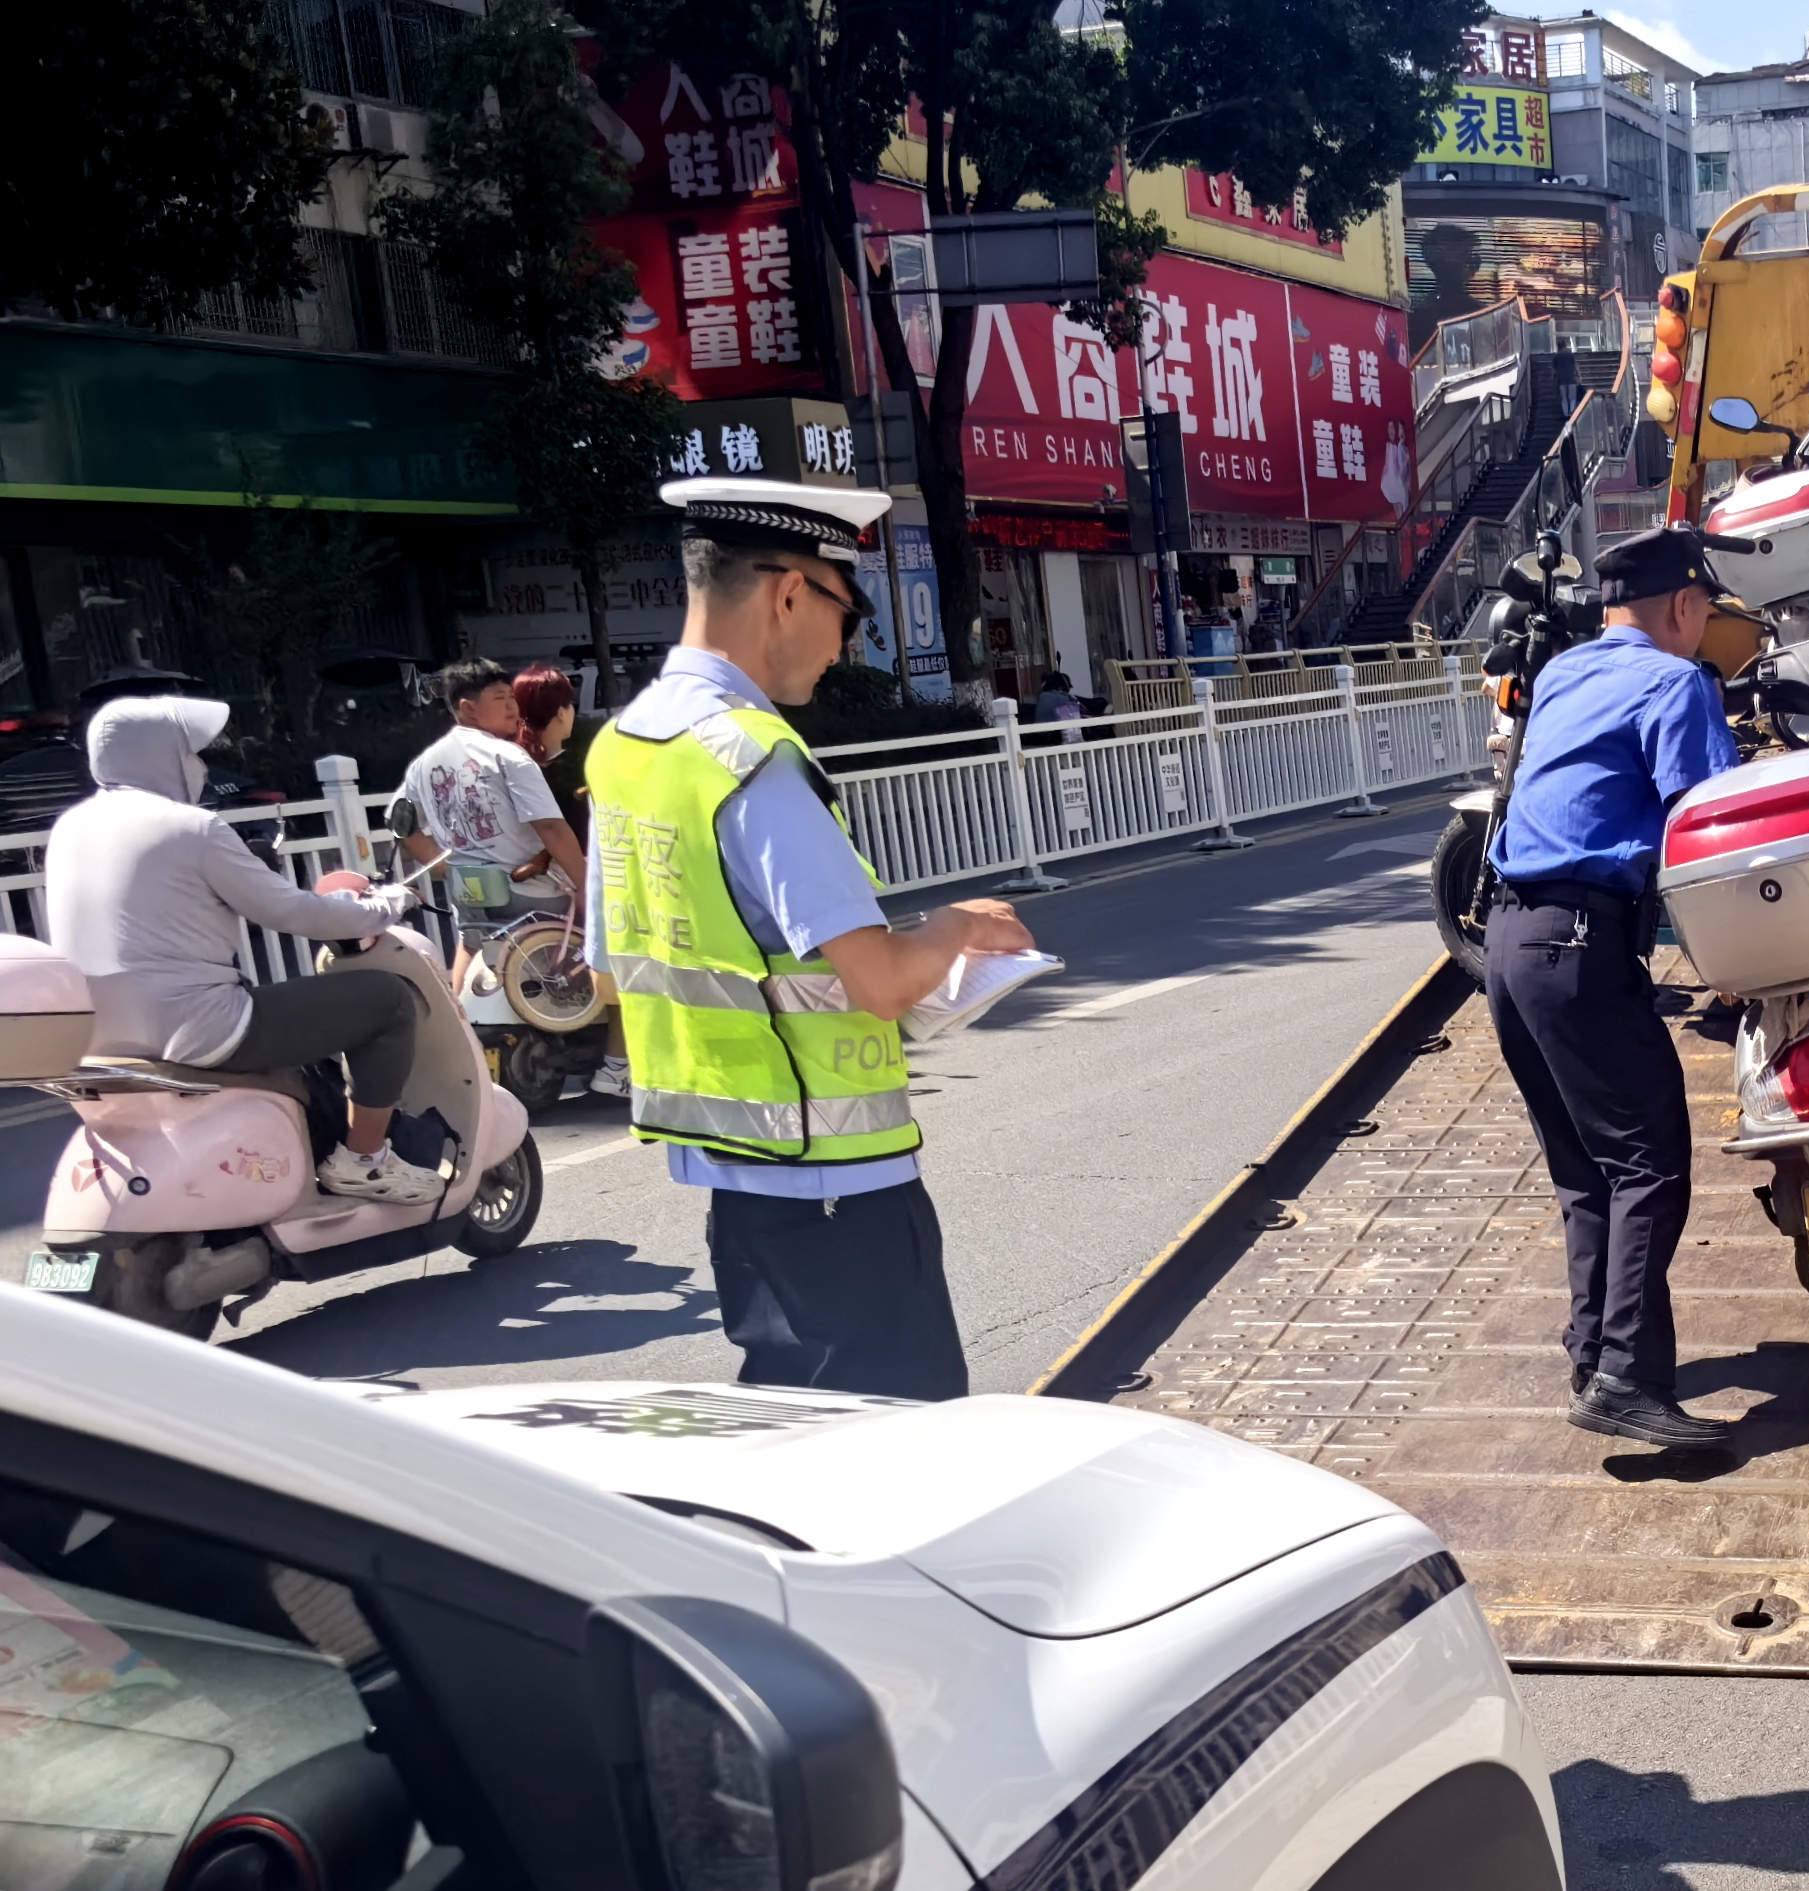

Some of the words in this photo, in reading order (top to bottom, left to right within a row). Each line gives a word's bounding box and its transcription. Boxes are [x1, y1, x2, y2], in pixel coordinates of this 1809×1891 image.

[664, 124, 783, 199] 鞋城
[1525, 95, 1546, 165] 超市
[678, 226, 793, 300] 童装
[686, 298, 801, 369] 童鞋
[1329, 344, 1382, 408] 童装
[973, 426, 1028, 460] REN
[1045, 435, 1124, 468] SHAN
[1200, 451, 1272, 483] CHENG
[1312, 420, 1367, 482] 童鞋
[597, 806, 682, 899] 警察
[608, 901, 693, 950] OLICE
[31, 1263, 91, 1288] 983092
